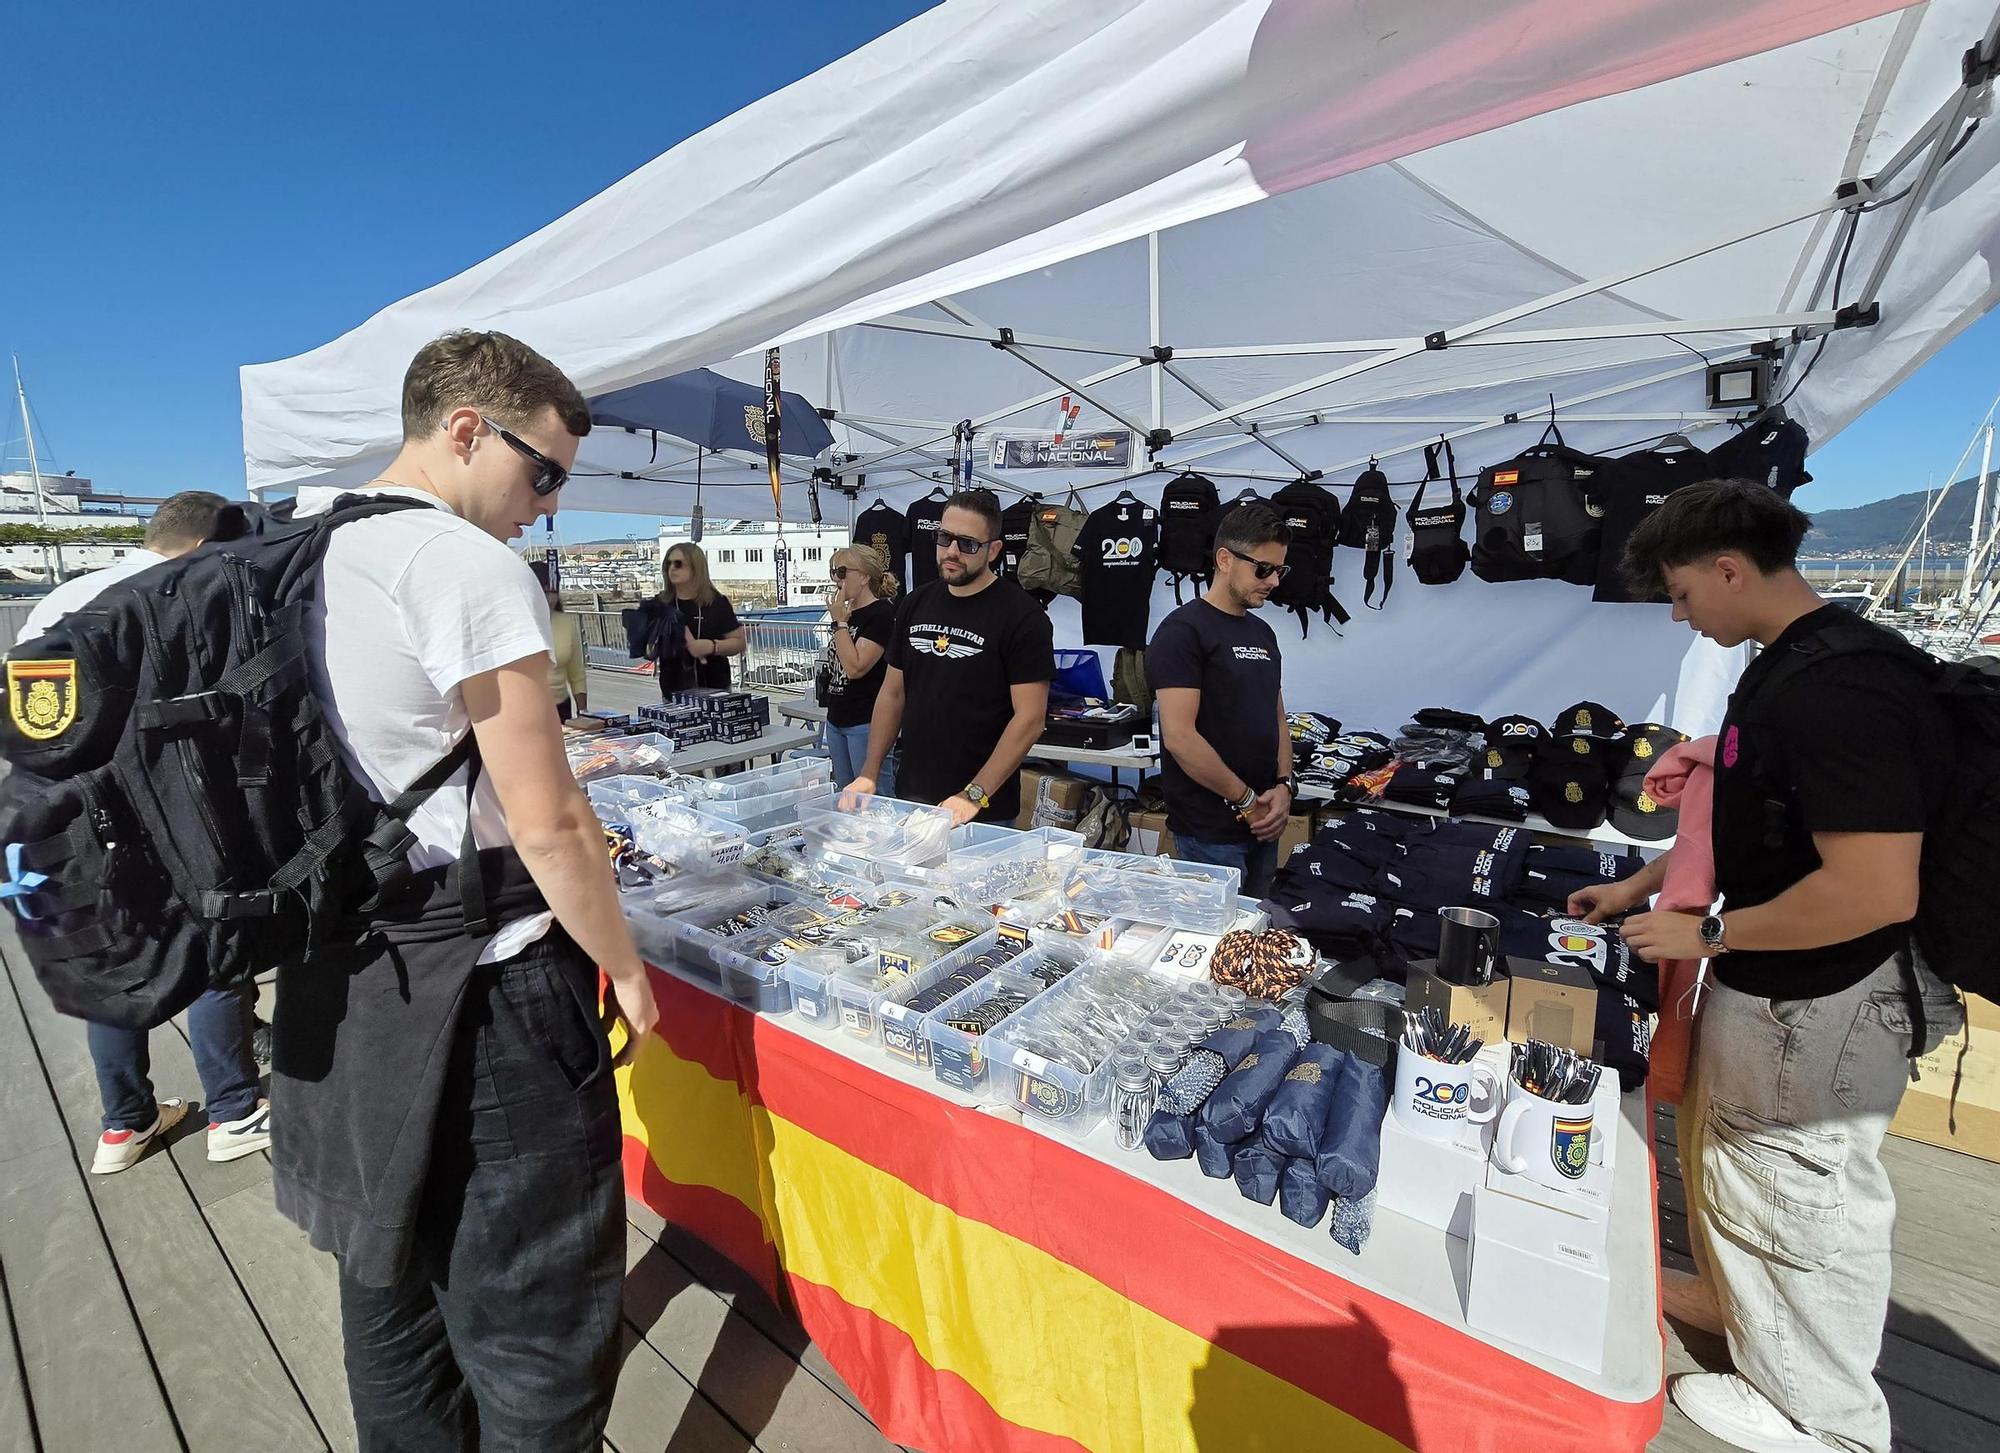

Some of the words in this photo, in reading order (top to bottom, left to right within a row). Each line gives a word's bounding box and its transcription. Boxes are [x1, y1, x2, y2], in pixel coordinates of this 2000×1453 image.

[1038, 439, 1099, 451] POLICIA
[1037, 450, 1115, 462] NACIONAL
[909, 624, 949, 634] ESTRELLA
[949, 627, 985, 646] MILITAR
[1232, 646, 1260, 655] POLICIA
[1235, 653, 1271, 661] NACIONAL
[1502, 722, 1539, 738] 200
[1310, 752, 1351, 774] 200
[1632, 1019, 1642, 1056] POLICIA
[1414, 1076, 1470, 1105] 200
[1412, 1098, 1460, 1114] POLICIA
[1412, 1104, 1467, 1120] NACIONAL
[1556, 1145, 1572, 1174] POLICIA
